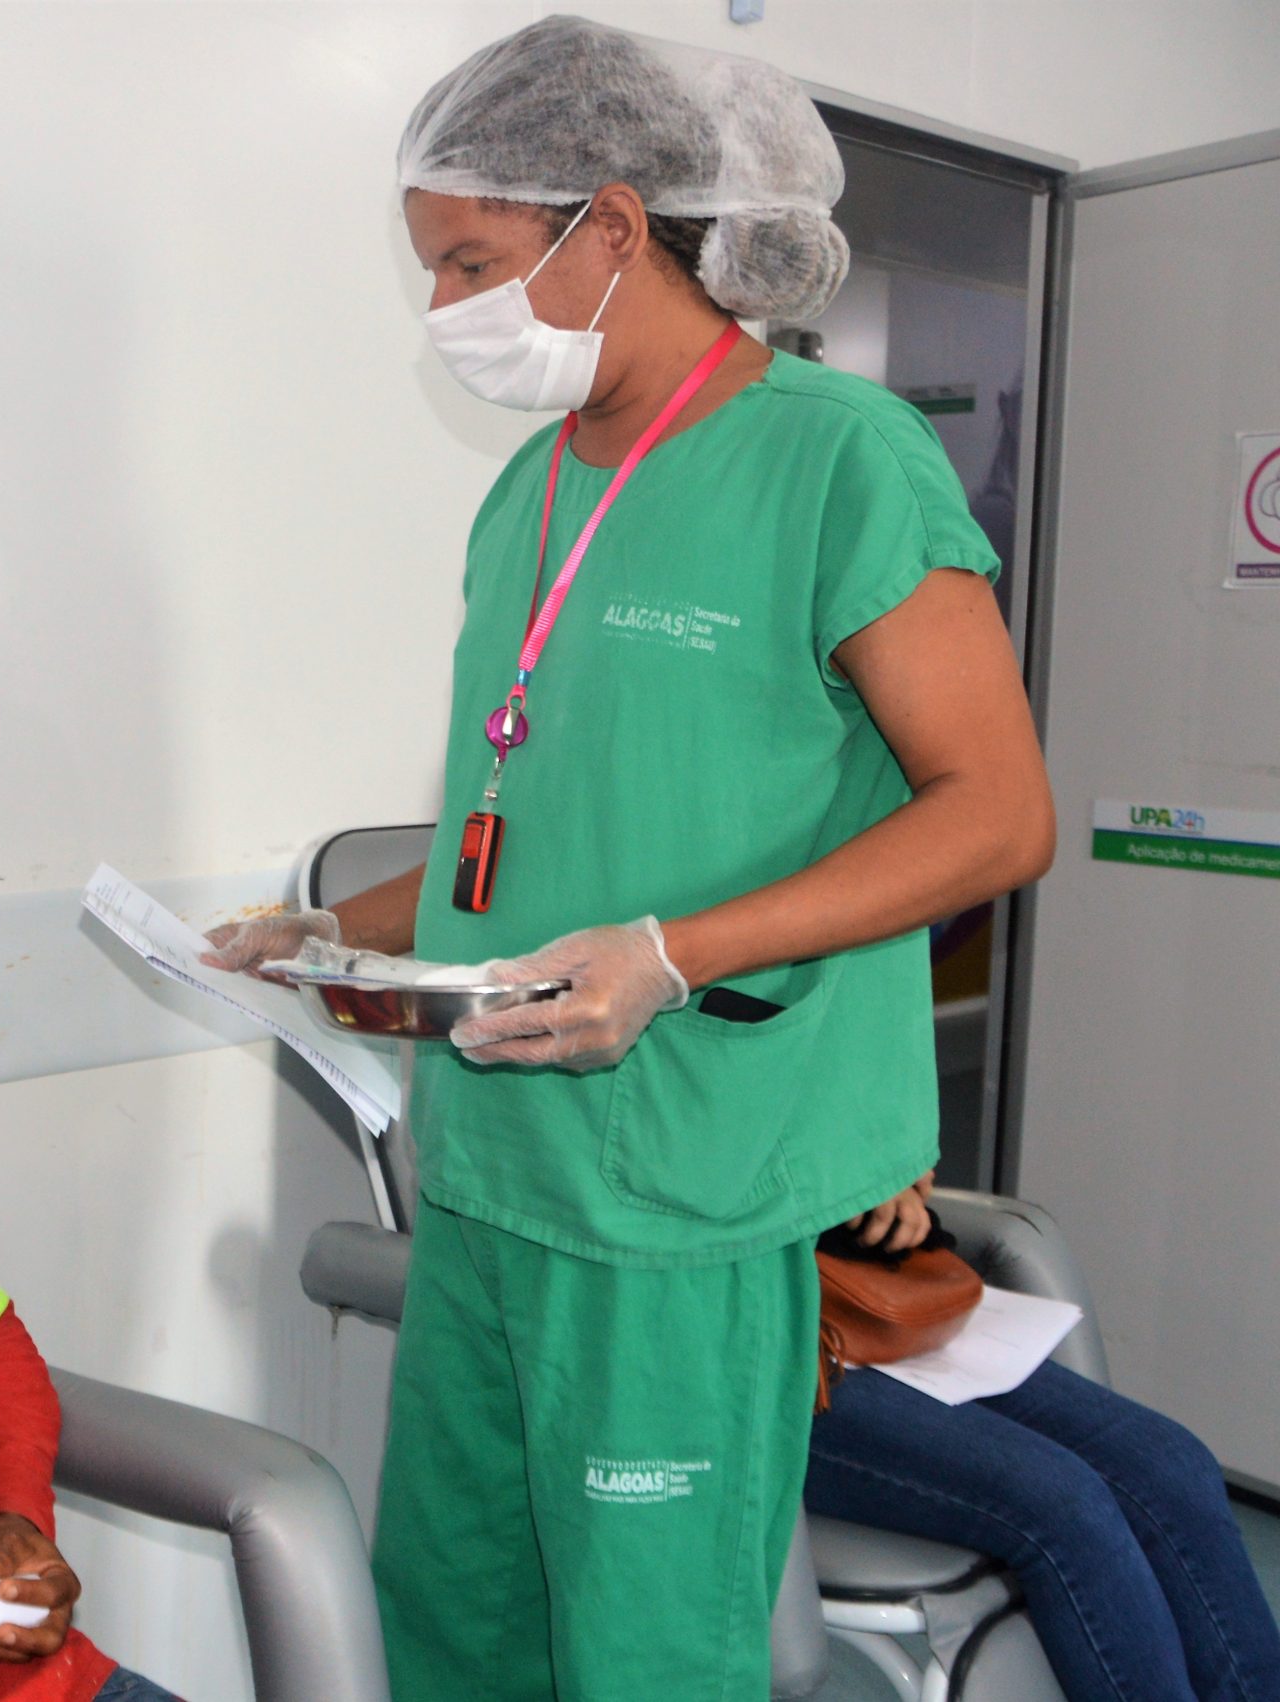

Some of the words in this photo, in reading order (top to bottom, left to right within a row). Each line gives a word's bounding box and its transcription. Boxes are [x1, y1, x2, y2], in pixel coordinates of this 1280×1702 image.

[1127, 843, 1187, 863] Aplicação
[1189, 851, 1206, 864] de
[585, 1466, 665, 1494] ALAGOAS
